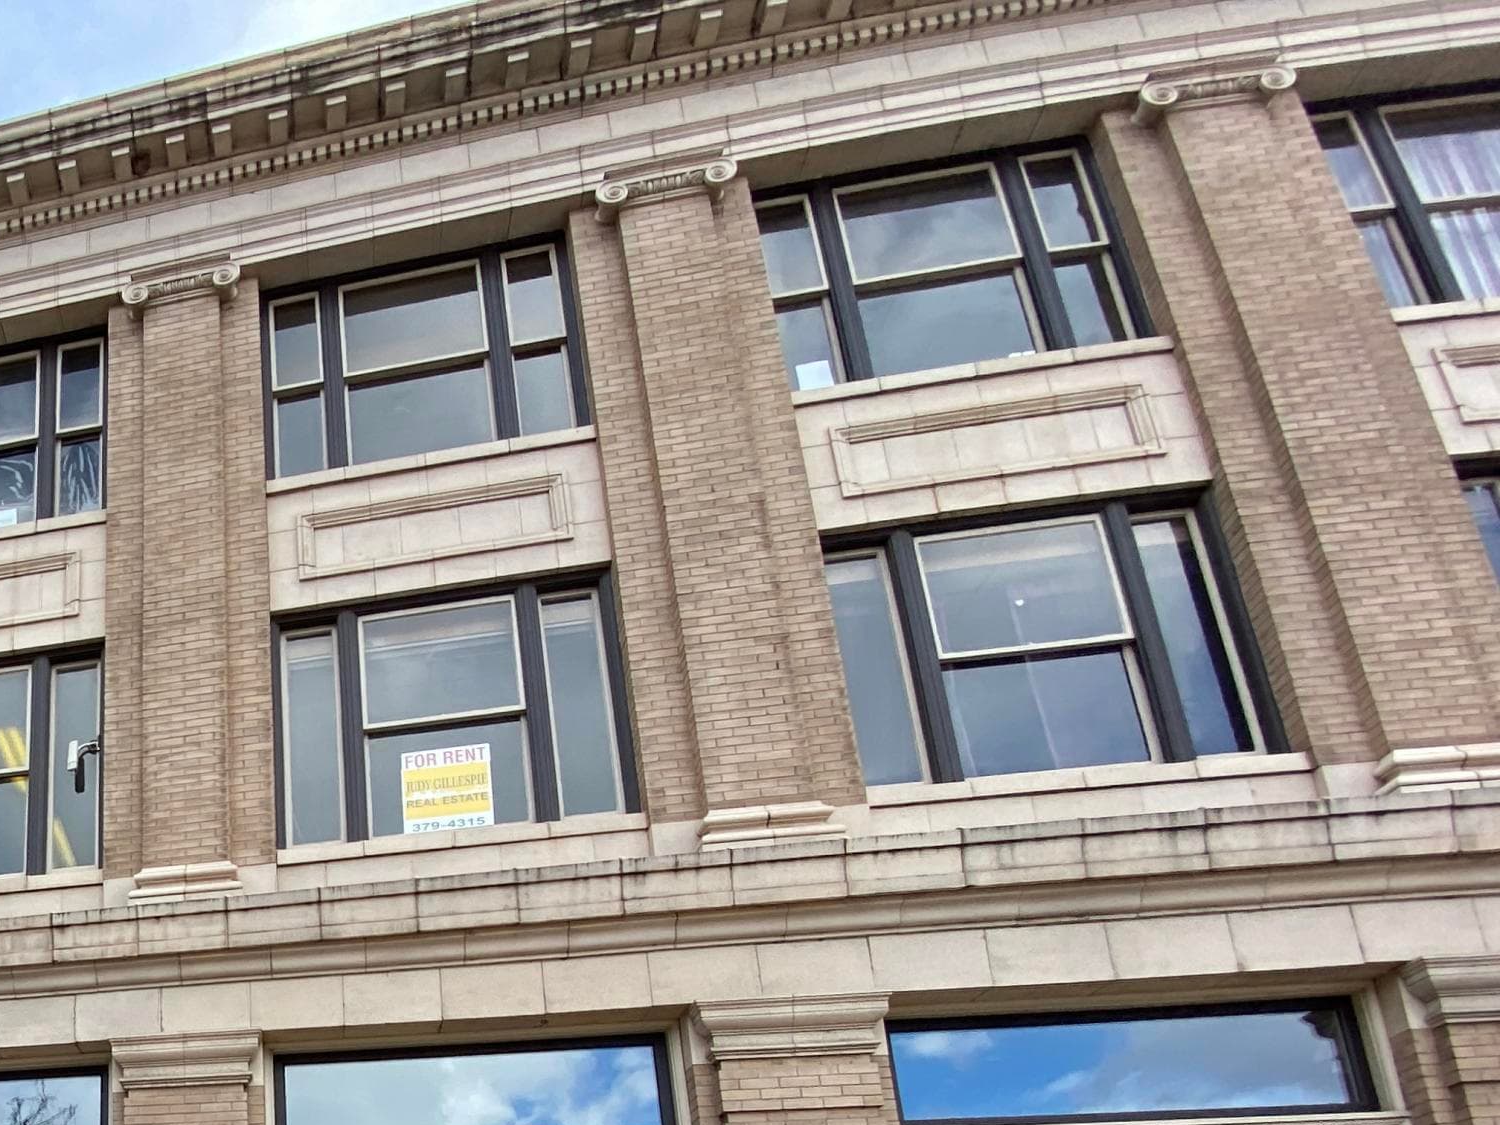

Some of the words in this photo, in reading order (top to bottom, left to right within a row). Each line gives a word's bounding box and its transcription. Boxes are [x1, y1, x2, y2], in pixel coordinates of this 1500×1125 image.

[404, 752, 437, 769] FOR
[443, 746, 486, 765] RENT
[406, 778, 430, 793] JUDY
[433, 772, 488, 791] GILLESPIE
[406, 799, 439, 809] REAL
[442, 791, 489, 805] ESTATE
[412, 816, 486, 832] 379-4315
